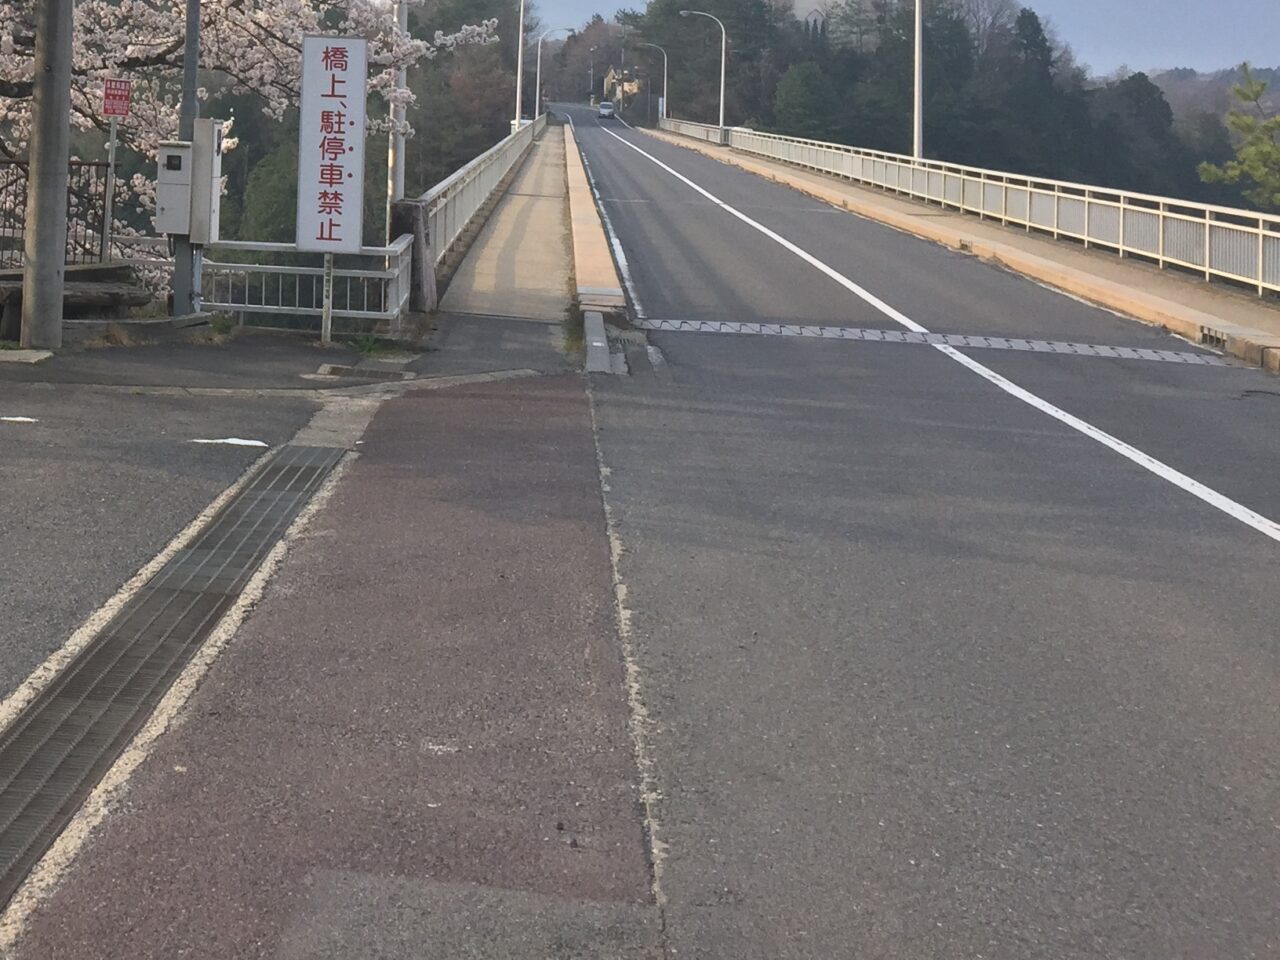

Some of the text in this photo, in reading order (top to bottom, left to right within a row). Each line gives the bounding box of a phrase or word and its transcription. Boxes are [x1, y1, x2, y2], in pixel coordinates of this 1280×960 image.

[315, 45, 349, 242] 橋上、駐停車禁止
